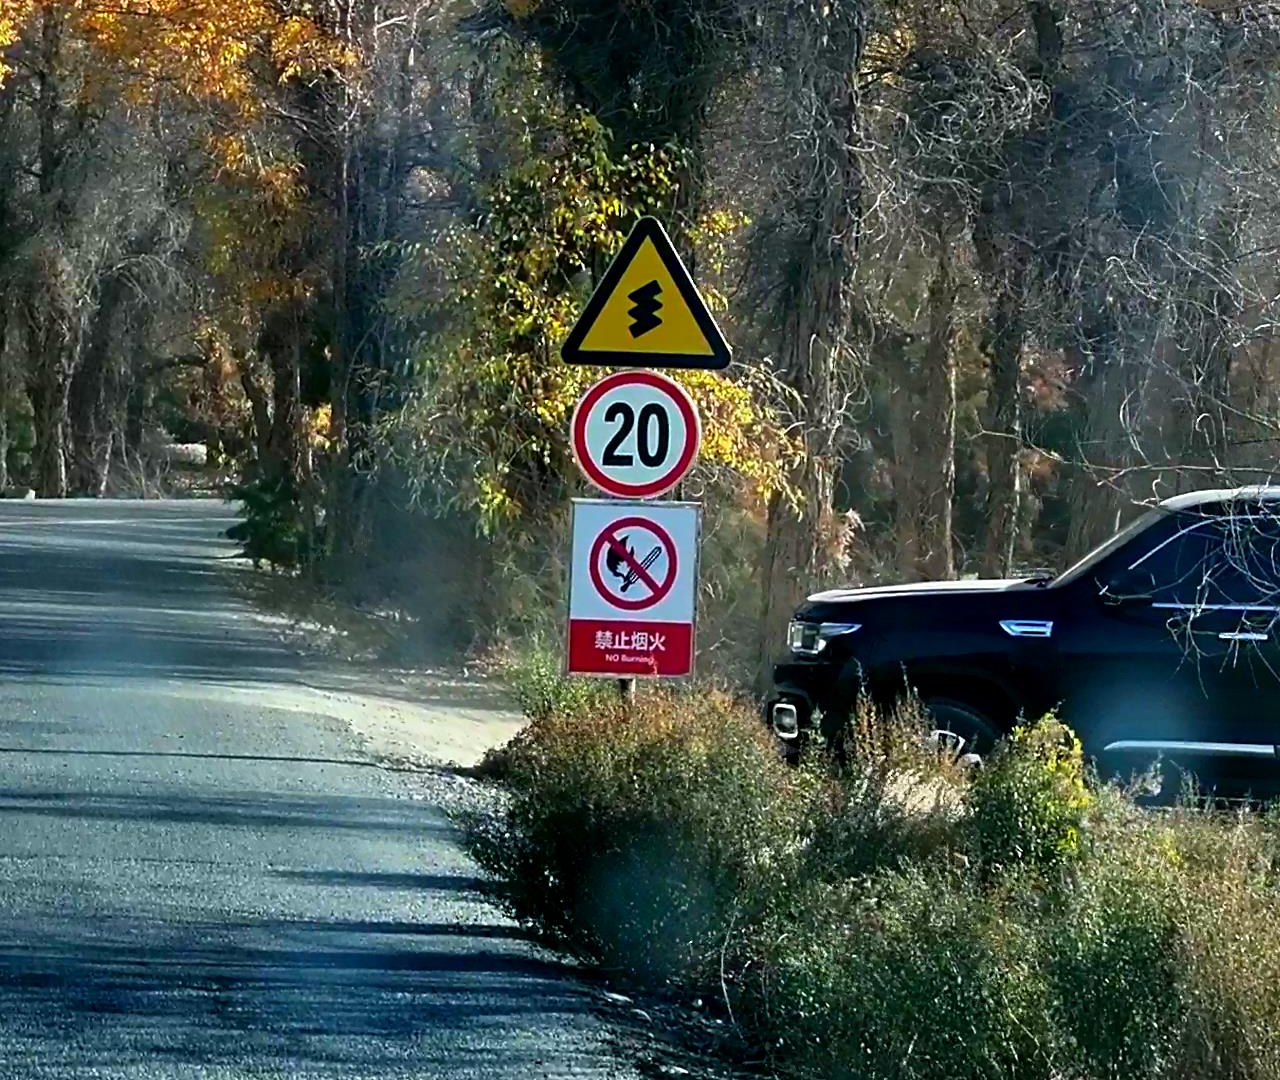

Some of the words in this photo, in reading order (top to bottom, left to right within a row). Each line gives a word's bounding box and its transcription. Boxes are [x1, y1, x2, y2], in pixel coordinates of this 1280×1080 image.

[602, 402, 669, 467] 20
[594, 630, 666, 651] 禁止烟火
[605, 653, 619, 662] NO
